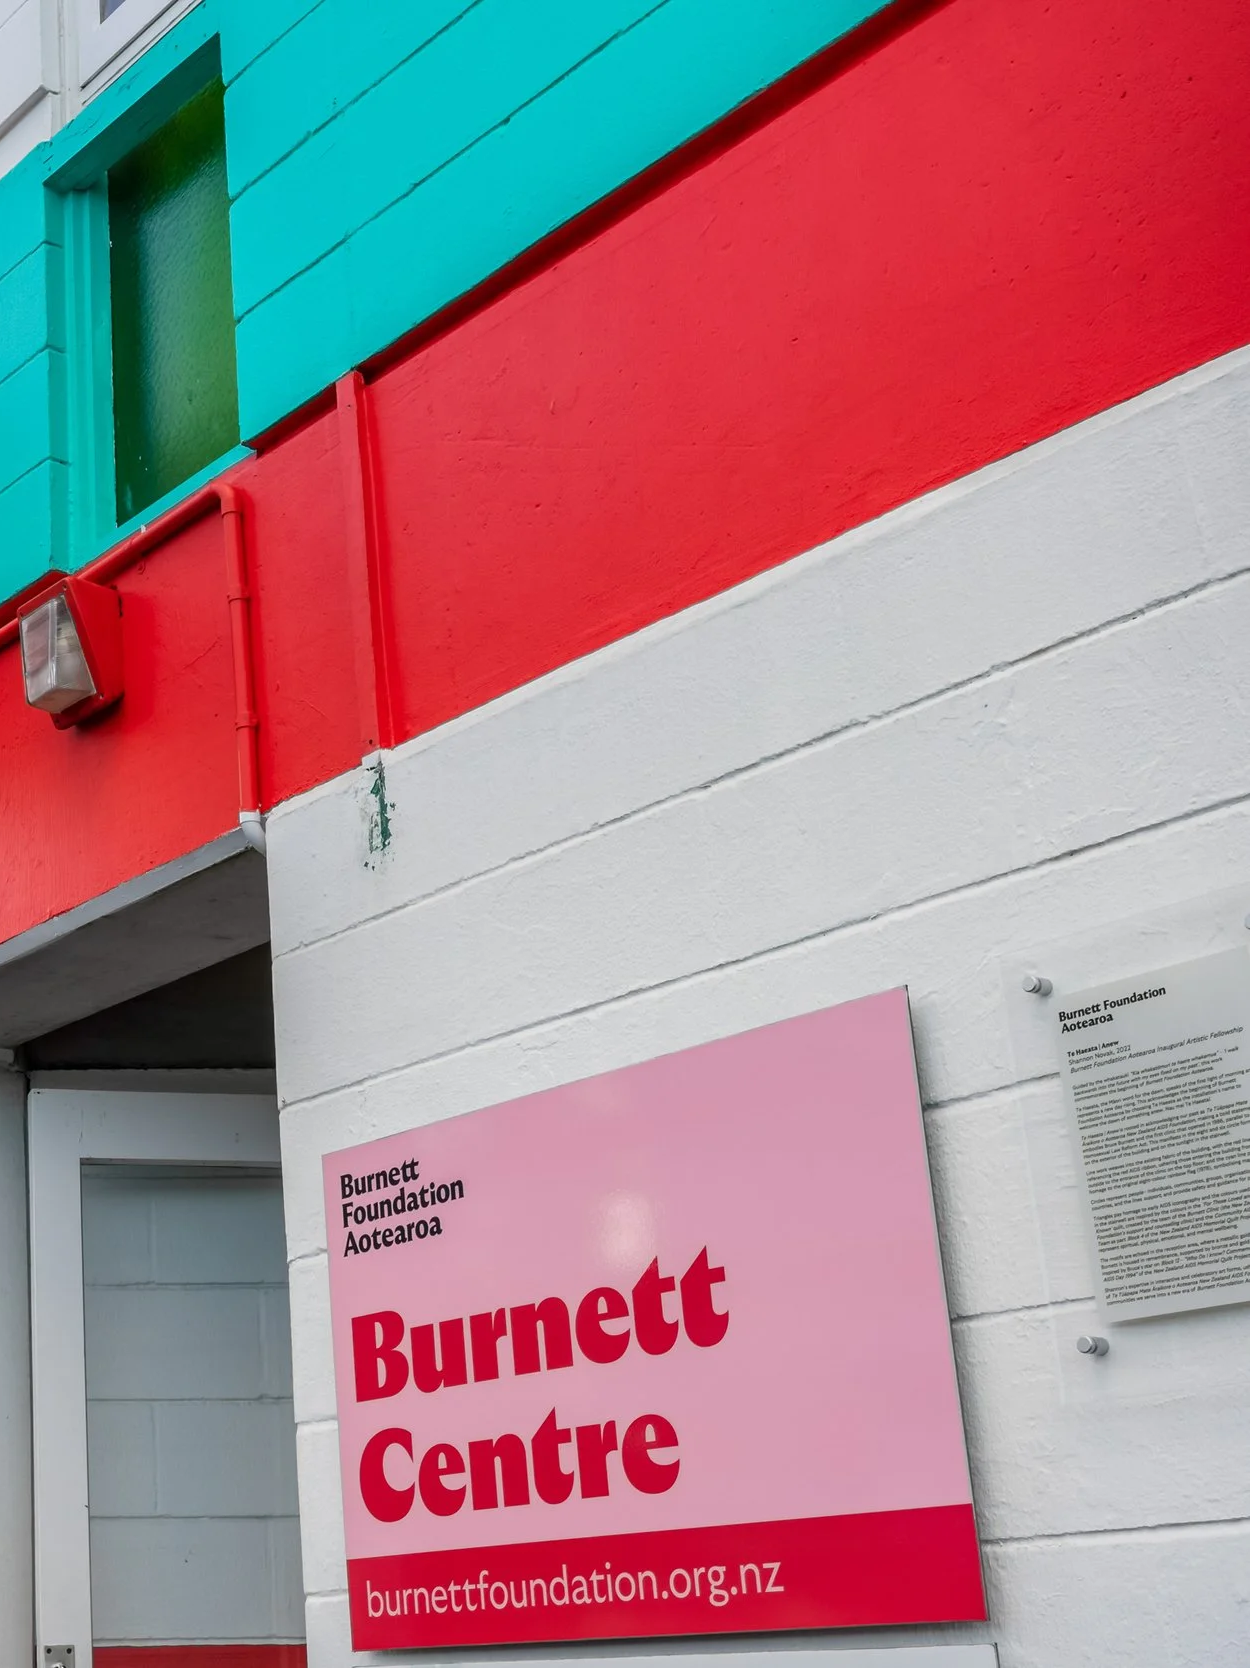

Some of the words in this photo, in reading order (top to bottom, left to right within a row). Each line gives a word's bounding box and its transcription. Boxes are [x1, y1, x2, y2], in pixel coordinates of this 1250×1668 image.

[1059, 1003, 1101, 1022] Burnett
[1103, 986, 1166, 1010] Foundation
[1061, 1013, 1113, 1034] Aotearoa
[1068, 1055, 1093, 1065] Shannon
[1070, 1063, 1092, 1073] Burnett
[1093, 1055, 1127, 1067] Foundation
[1128, 1048, 1155, 1059] Aotearoa
[1156, 1039, 1185, 1052] Inaugural
[1186, 1035, 1208, 1045] Artistic
[1209, 1026, 1243, 1039] Fellowship
[1075, 1046, 1098, 1055] Haeata
[340, 1157, 420, 1200] Burnett
[341, 1179, 465, 1228] Foundation
[343, 1216, 443, 1258] Aotearoa
[351, 1244, 730, 1403] Burnett
[359, 1406, 681, 1523] Centre
[366, 1560, 785, 1618] burnettfoundation.org.nz
